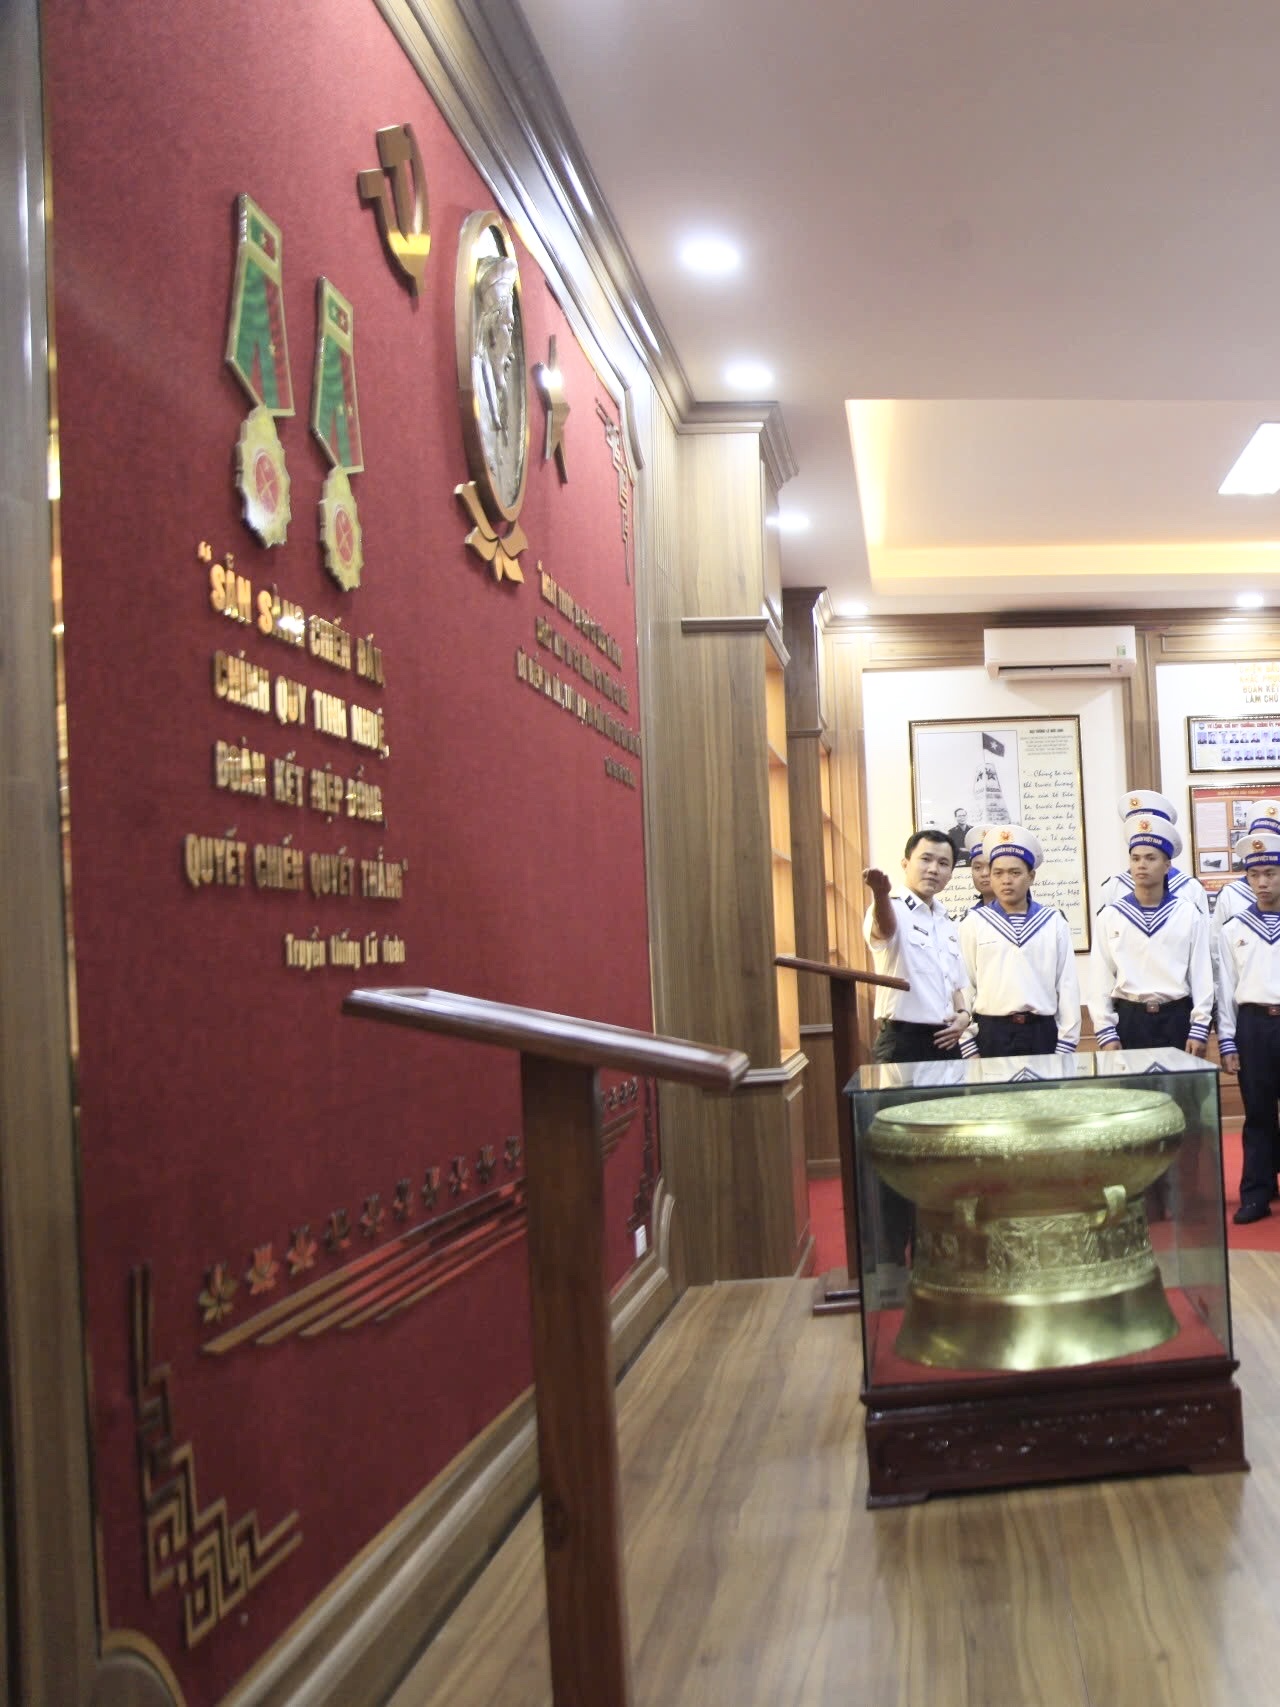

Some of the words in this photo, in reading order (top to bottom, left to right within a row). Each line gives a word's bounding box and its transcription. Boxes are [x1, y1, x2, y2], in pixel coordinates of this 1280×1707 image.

[257, 584, 305, 647] SÀNG
[309, 614, 351, 671] CHIẾN
[215, 651, 270, 713] CHÍNH
[275, 676, 307, 725] QUY
[1246, 693, 1261, 704] LÀM
[1264, 694, 1279, 703] CHỦ
[216, 736, 267, 797] ĐOÀN
[274, 751, 304, 807] KẾT
[311, 762, 344, 823] HIỆP
[185, 827, 247, 891] QUYẾT
[254, 834, 304, 890] CHIẾN
[310, 847, 354, 898] QUYẾT
